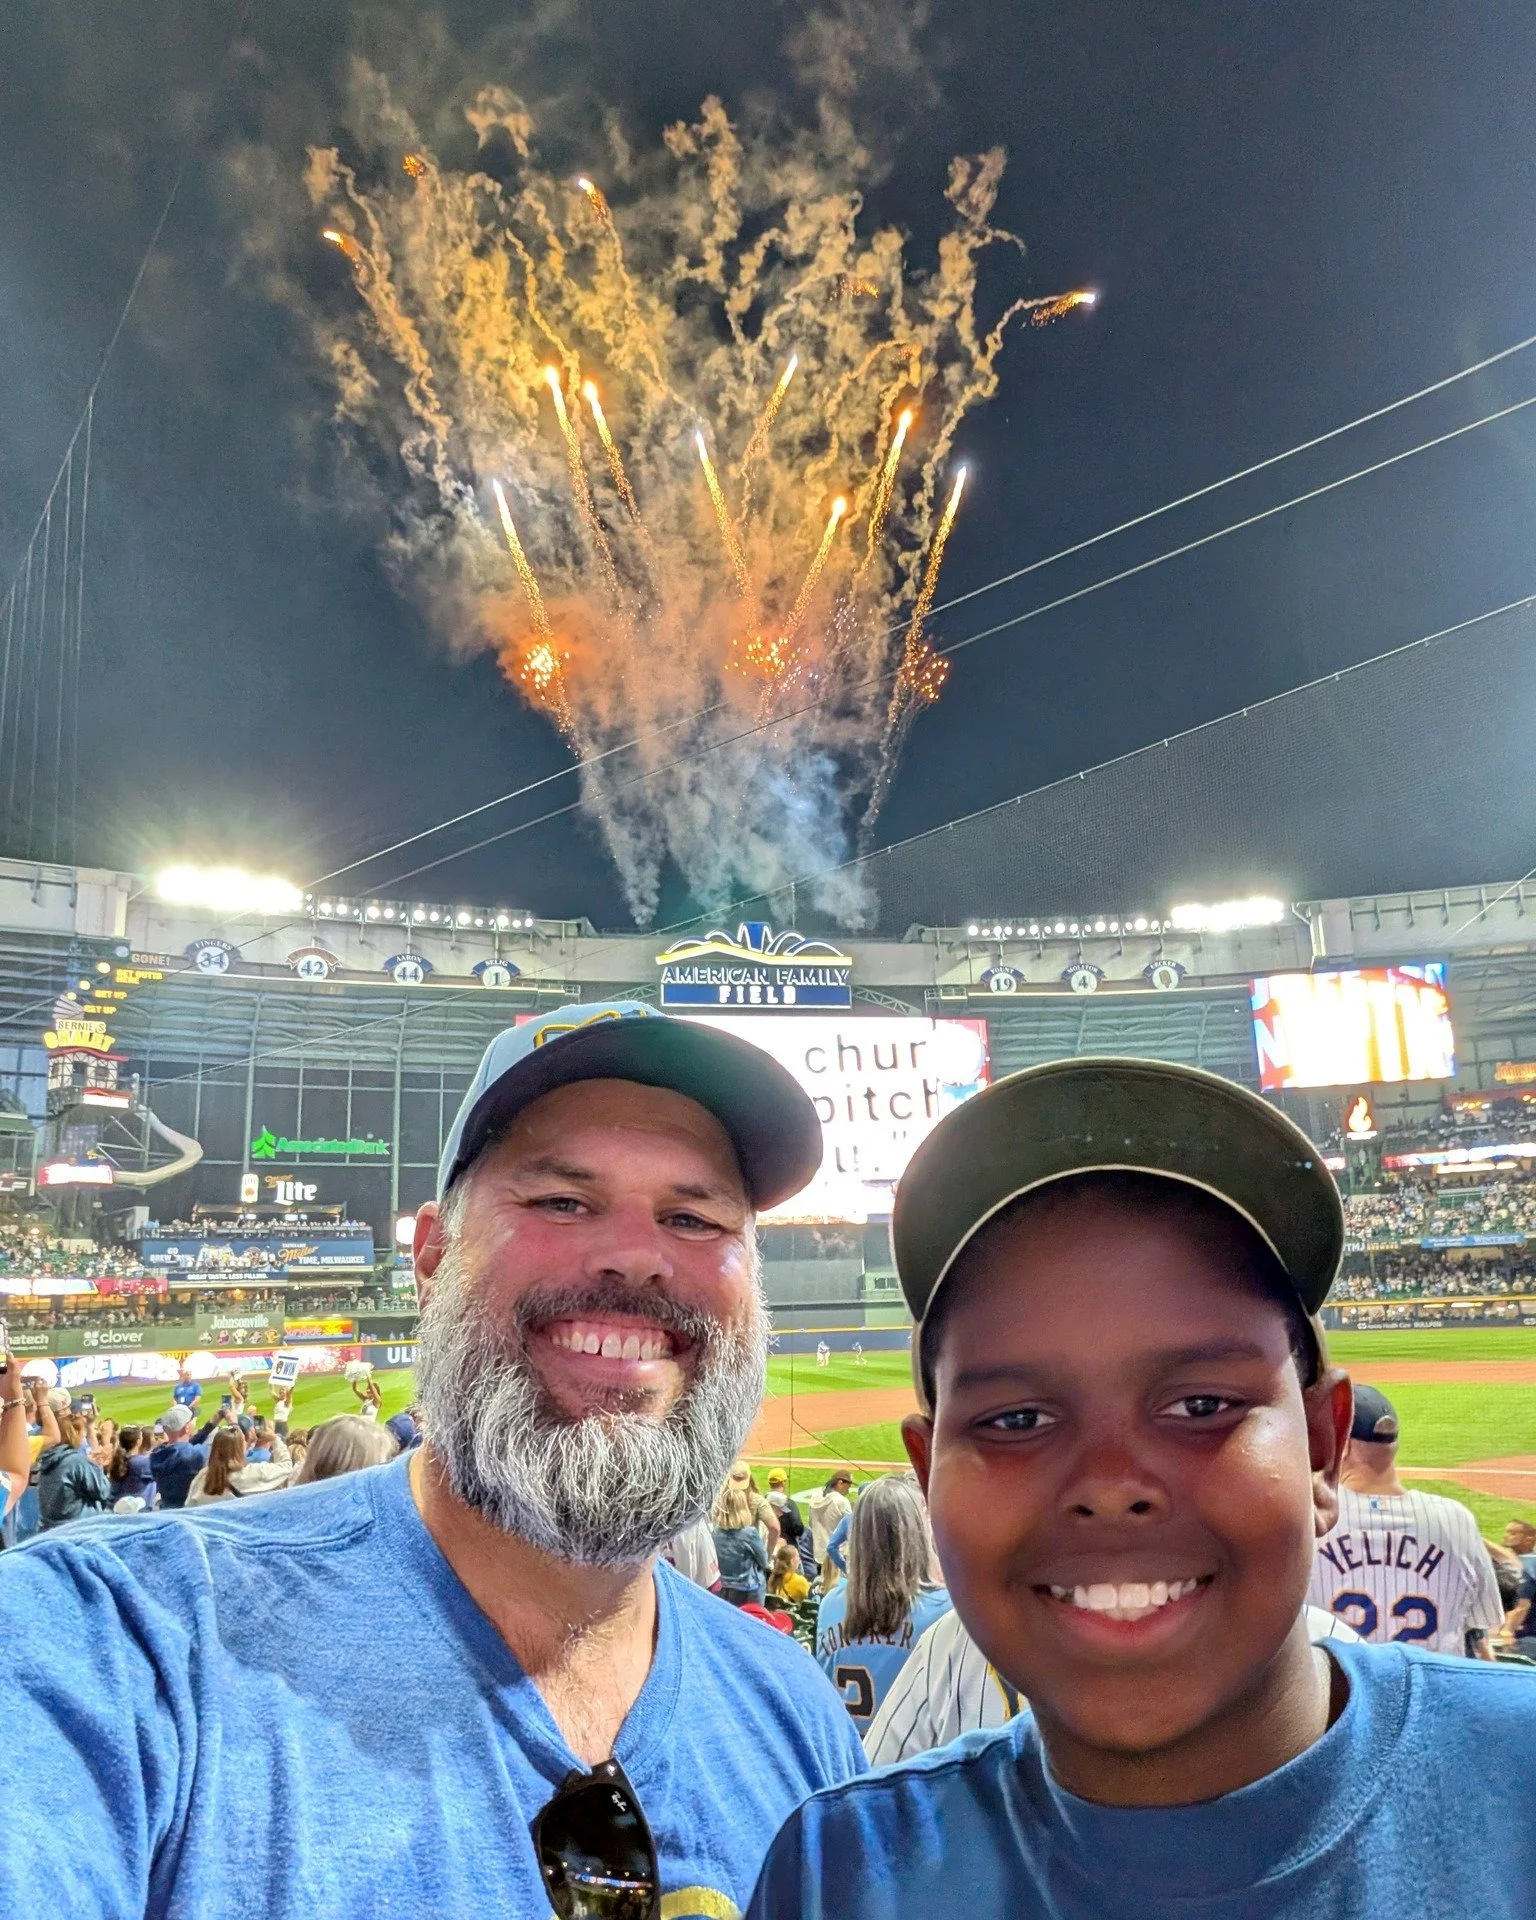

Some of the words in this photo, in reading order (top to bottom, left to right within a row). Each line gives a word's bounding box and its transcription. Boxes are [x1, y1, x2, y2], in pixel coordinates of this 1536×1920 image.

[131, 953, 170, 966] GONE!
[199, 952, 225, 968] 34
[396, 953, 423, 964] AARON
[485, 959, 508, 967] SELIG
[300, 960, 325, 976] 42
[396, 966, 420, 981] 44
[989, 967, 1014, 975] YOUNT
[1066, 964, 1099, 974] MOLITOR
[493, 972, 501, 985] 1
[661, 967, 770, 984] AMERICAN
[775, 968, 850, 987] FAMILY
[1078, 975, 1089, 988] 4
[993, 978, 1013, 991] 19
[93, 989, 113, 999] GET
[113, 991, 128, 1000] UP
[718, 985, 797, 1005] FIELD
[82, 1004, 102, 1014] GET
[102, 1005, 117, 1015] UP
[273, 1180, 318, 1206] Lite
[167, 1247, 179, 1255] GO
[277, 1246, 319, 1262] Miller
[299, 1256, 320, 1265] TIME,
[321, 1255, 365, 1265] MILWAUKEE
[211, 1315, 269, 1330] Johnsonville
[100, 1330, 143, 1343] clover
[1318, 1530, 1445, 1580] YELICH
[1331, 1591, 1440, 1643] 22
